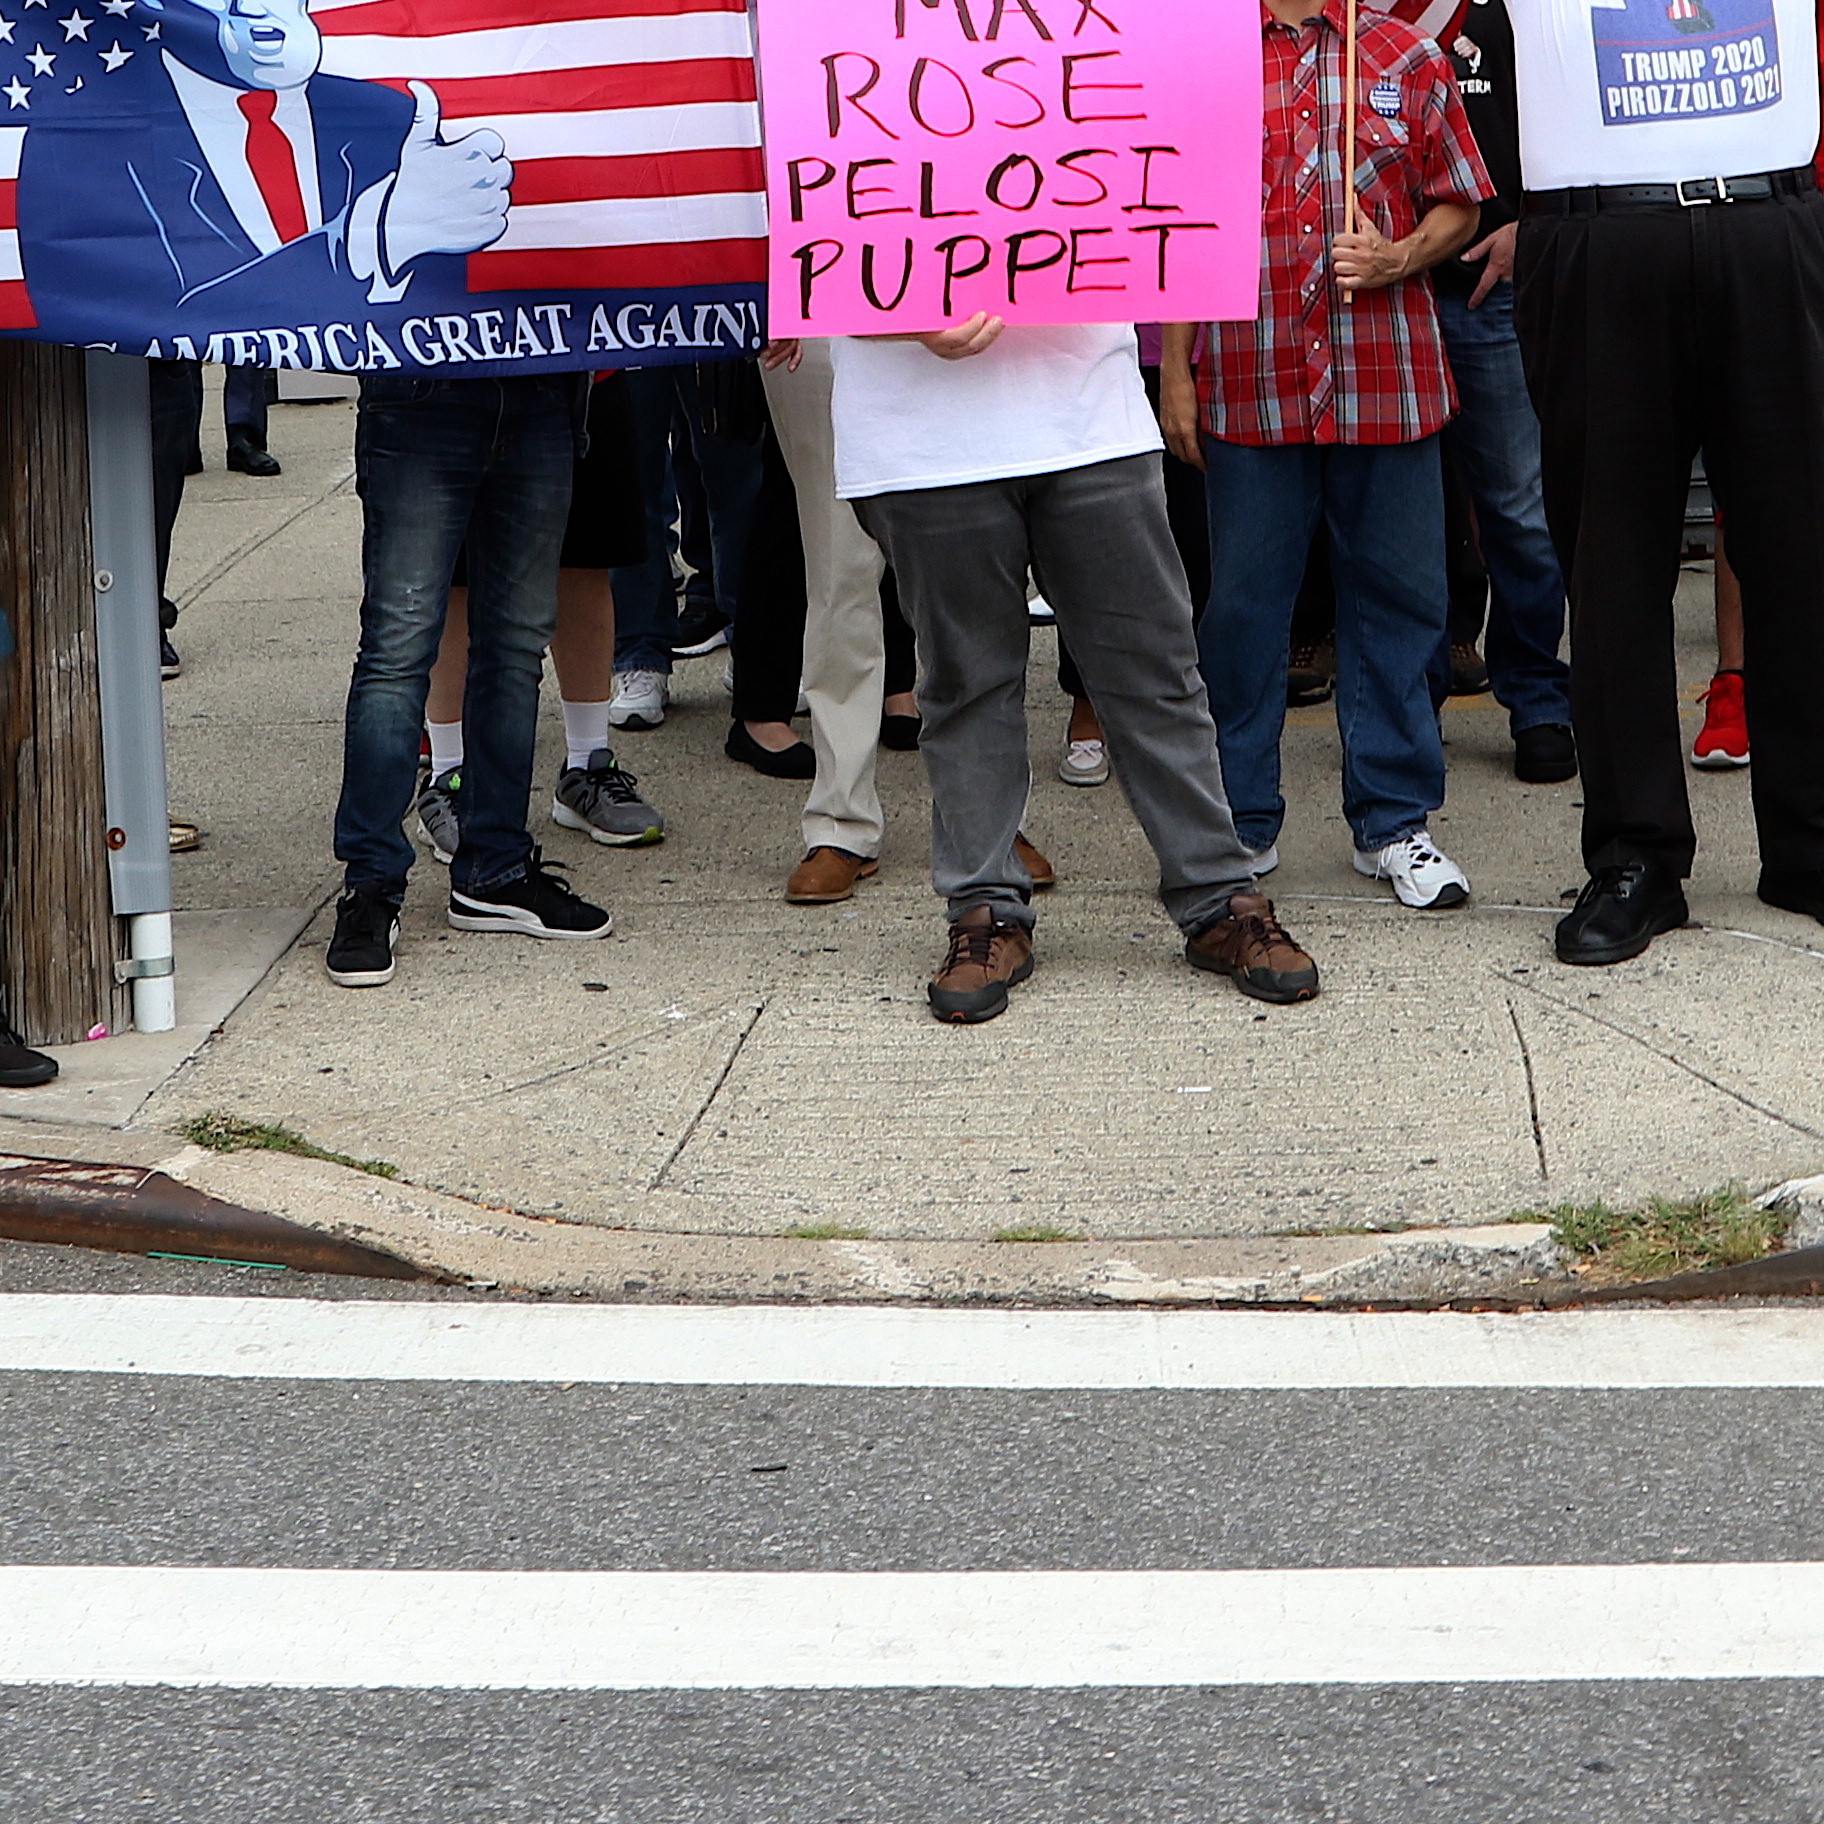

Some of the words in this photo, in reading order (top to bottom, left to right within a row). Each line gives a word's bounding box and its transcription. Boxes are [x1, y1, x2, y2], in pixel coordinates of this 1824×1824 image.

[820, 49, 1148, 140] ROSE
[1620, 49, 1706, 83] TRUMP
[1710, 35, 1765, 74] 2020
[1606, 75, 1738, 120] PIROZZOLO
[786, 146, 1184, 223] PELOSI
[790, 223, 1220, 320] PUPPET
[399, 304, 575, 366] GREAT
[585, 301, 761, 354] AGAIN!
